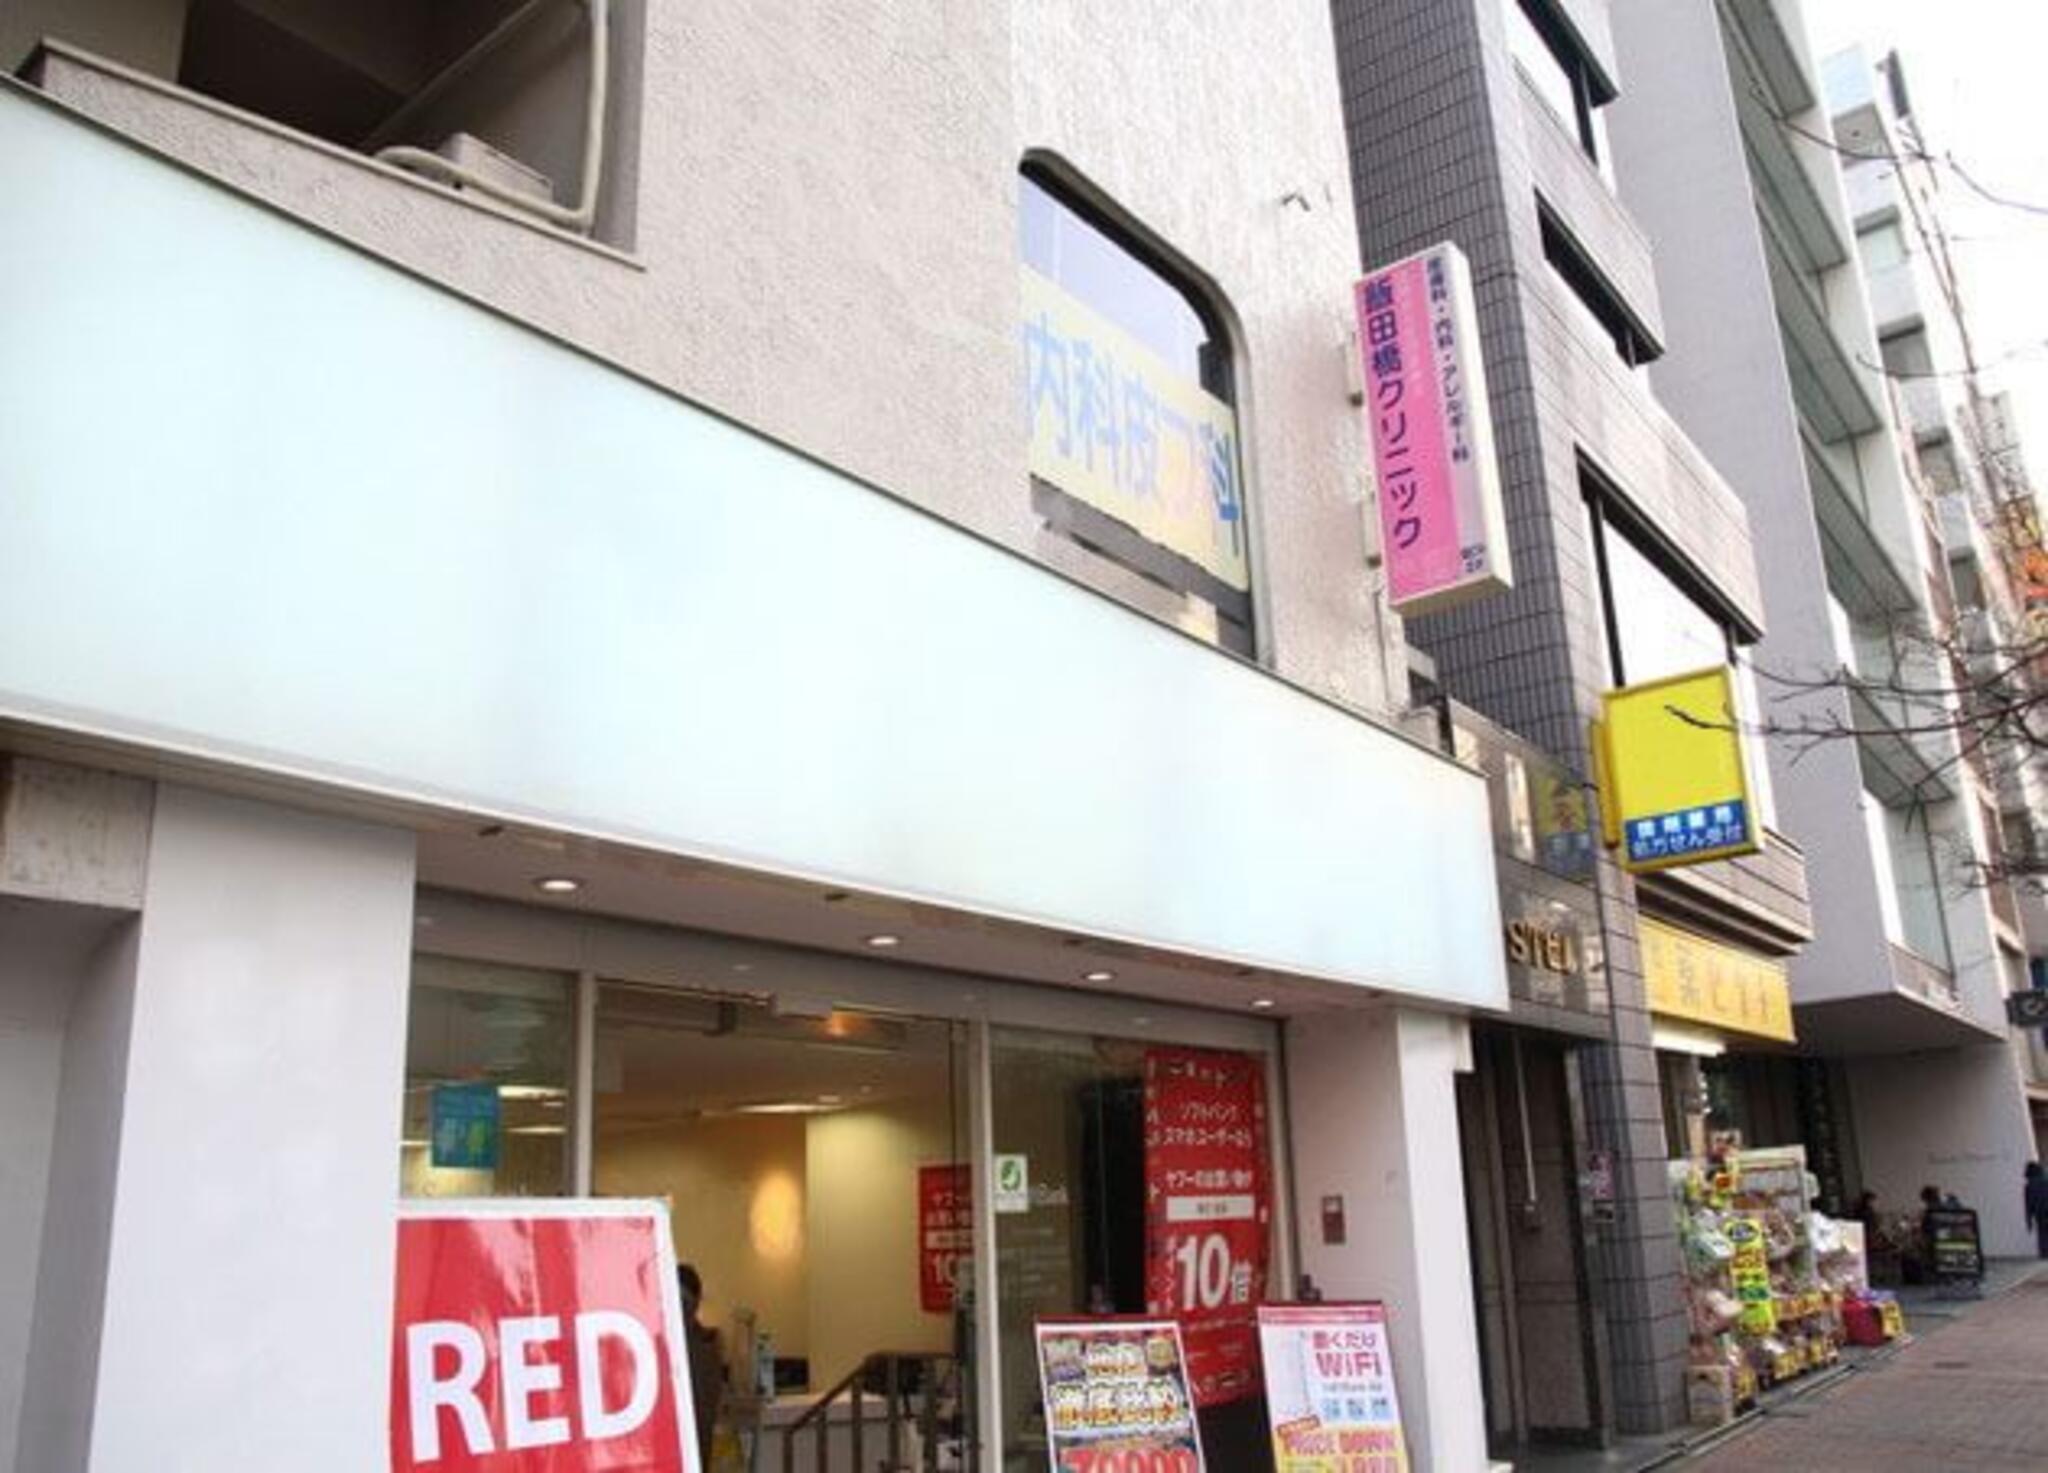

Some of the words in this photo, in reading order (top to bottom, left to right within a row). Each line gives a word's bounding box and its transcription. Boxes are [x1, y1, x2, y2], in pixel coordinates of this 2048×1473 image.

[1365, 275, 1421, 550] 飯田橋クリニック
[406, 1310, 660, 1464] RED
